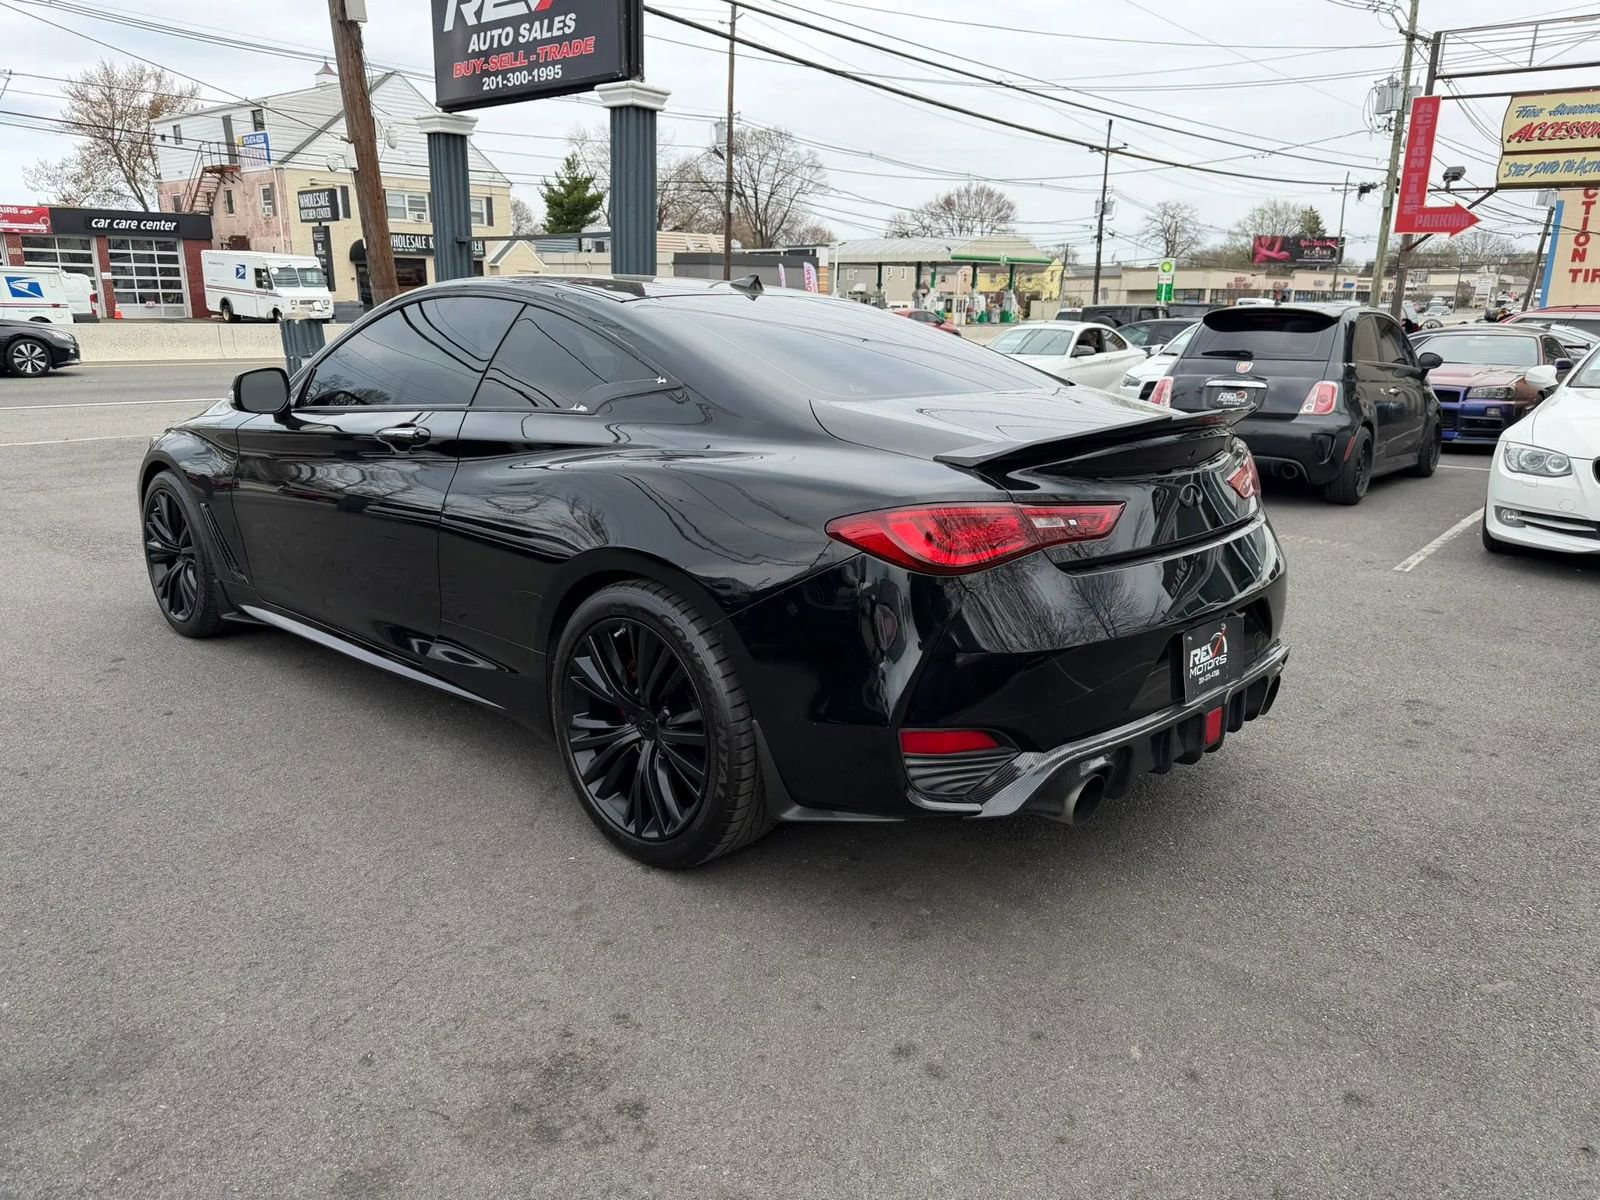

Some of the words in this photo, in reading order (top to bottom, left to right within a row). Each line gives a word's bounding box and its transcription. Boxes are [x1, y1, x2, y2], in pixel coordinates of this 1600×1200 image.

[468, 26, 514, 53] AUTO
[518, 13, 577, 44] SALES
[482, 64, 563, 91] 201-300-1995
[1409, 102, 1433, 168] ACTION
[298, 191, 330, 207] WHOLESALE
[1402, 172, 1424, 214] TIRE
[91, 217, 111, 229] car
[113, 218, 138, 230] care
[140, 219, 177, 232] center
[1414, 212, 1469, 228] PARKING
[1189, 636, 1223, 668] REV
[1189, 653, 1228, 679] MOTORS
